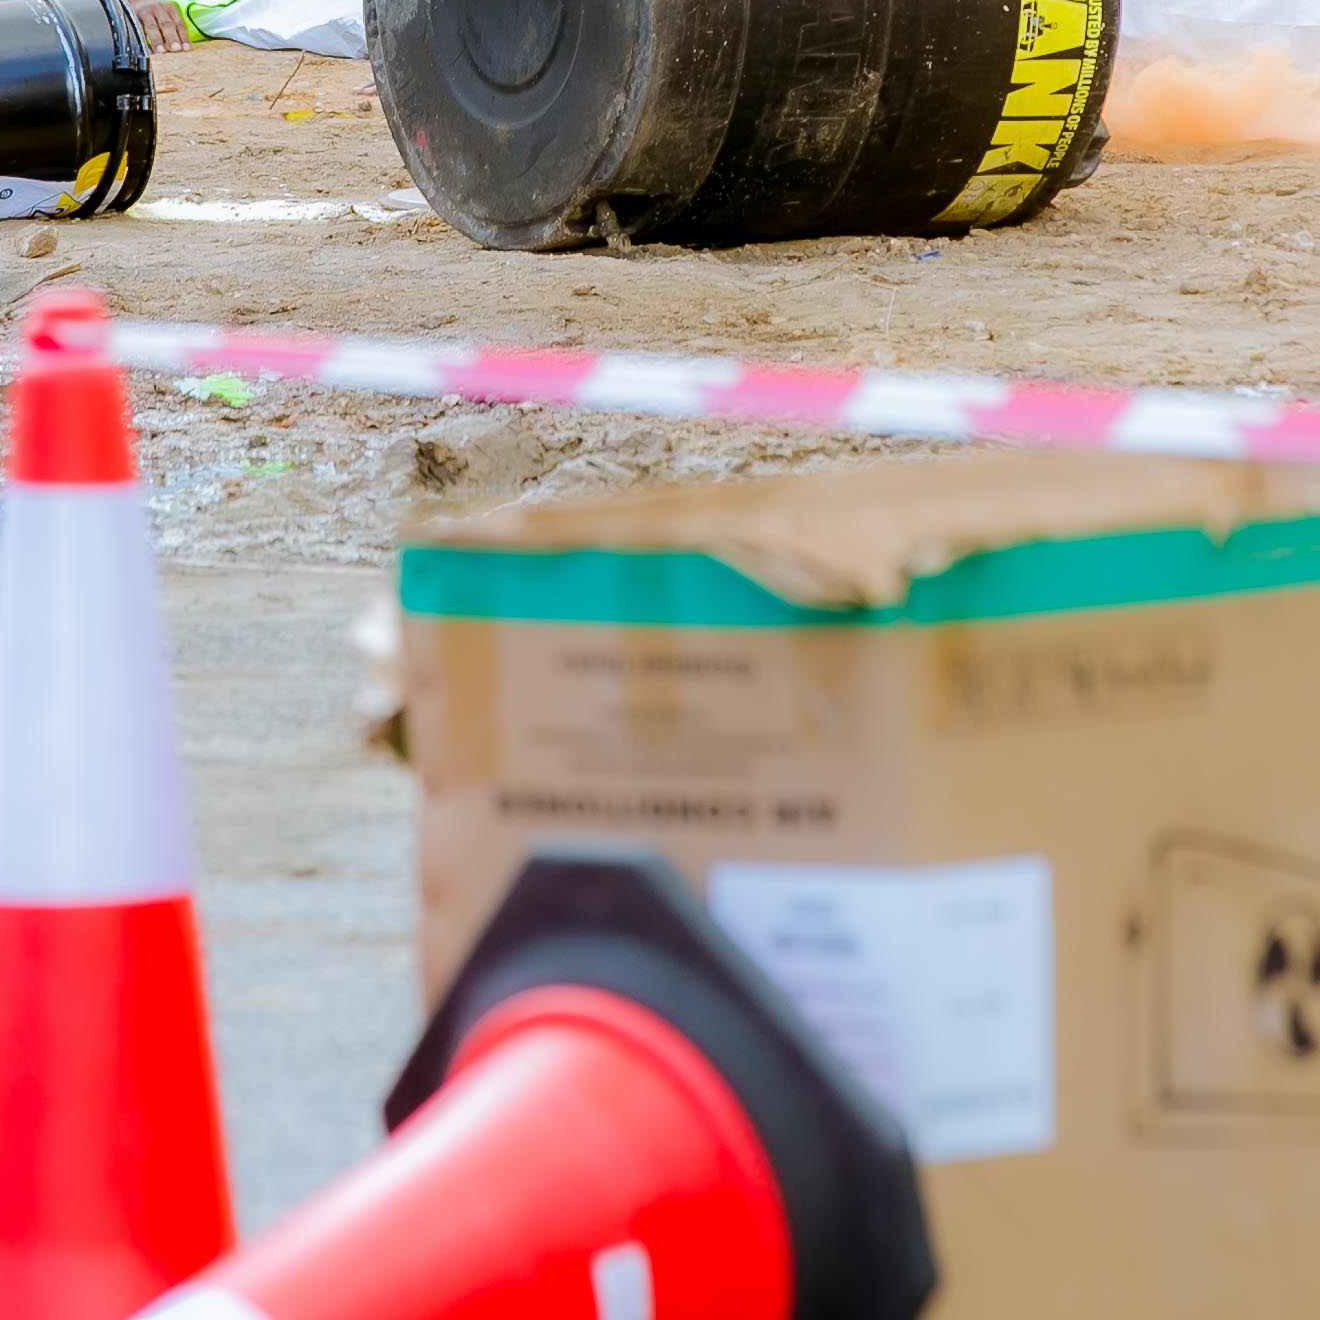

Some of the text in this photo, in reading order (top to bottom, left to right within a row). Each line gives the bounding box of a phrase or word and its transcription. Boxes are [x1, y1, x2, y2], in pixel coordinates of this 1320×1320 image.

[1084, 39, 1099, 58] BY
[1071, 58, 1097, 114] MILLIONS
[1065, 115, 1081, 130] OF
[1046, 131, 1074, 168] PEOPLE
